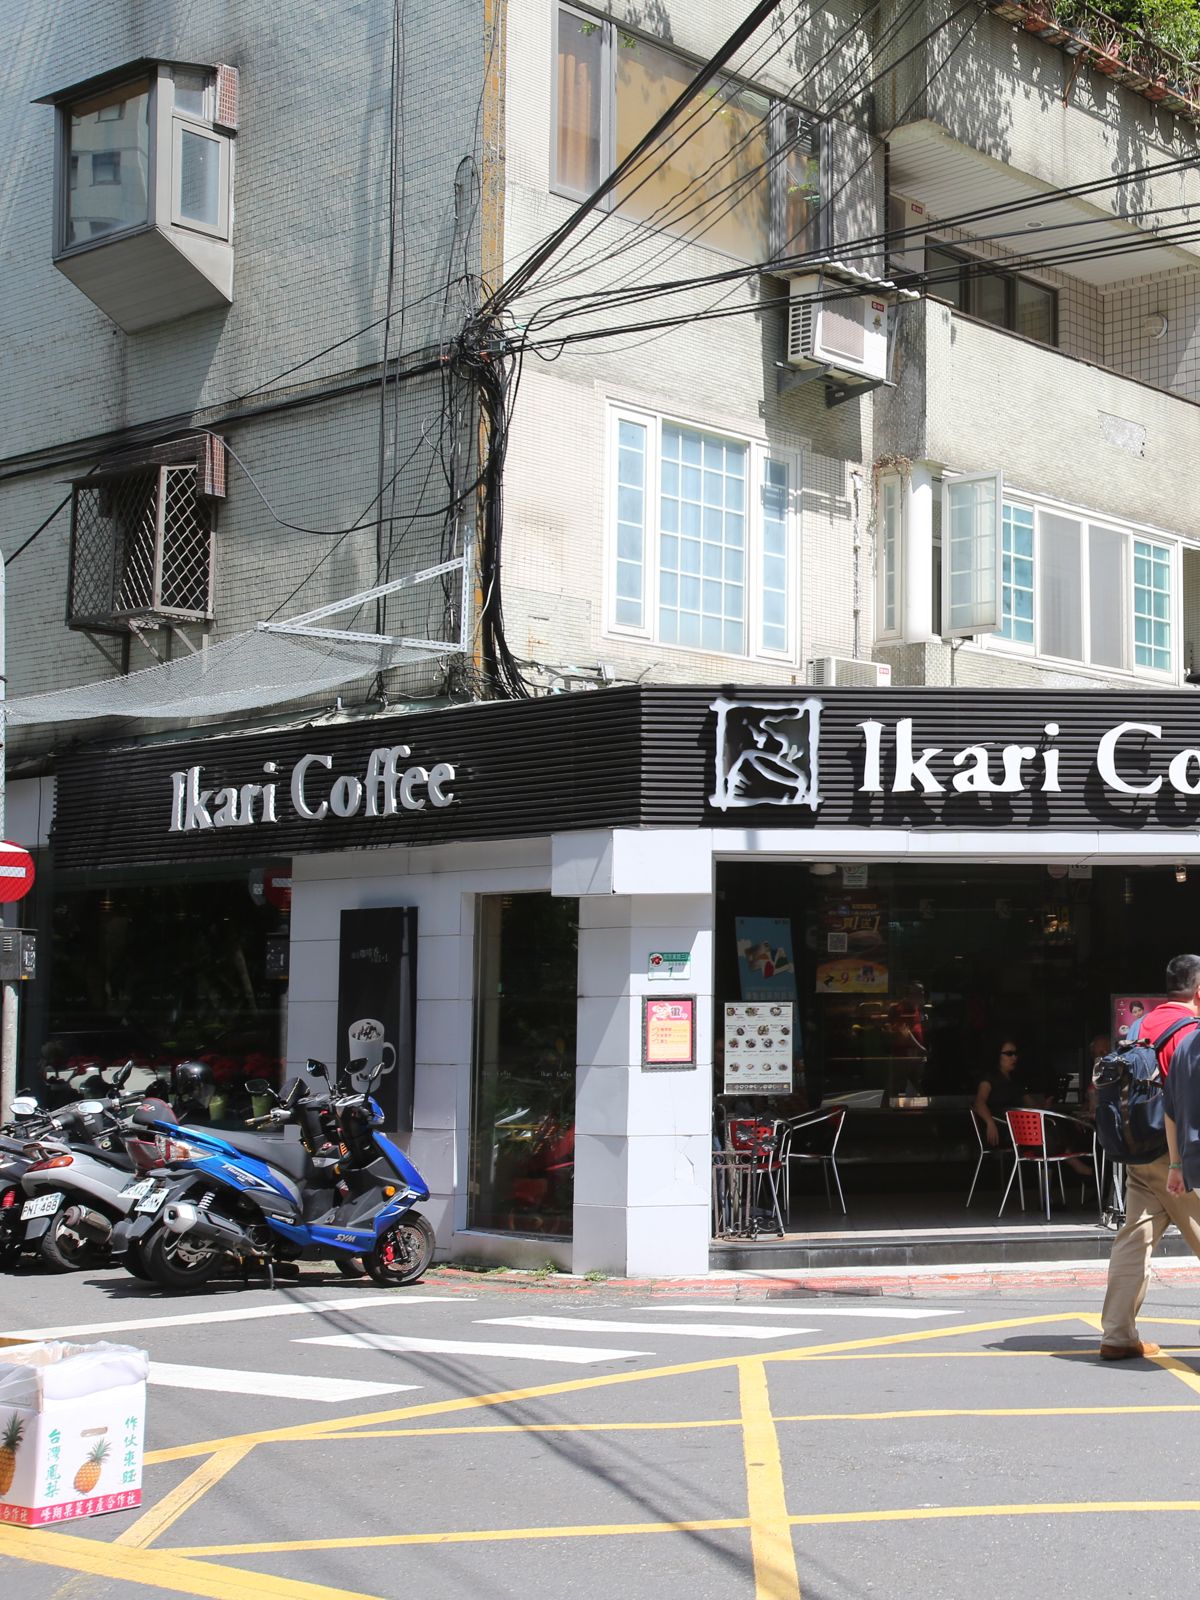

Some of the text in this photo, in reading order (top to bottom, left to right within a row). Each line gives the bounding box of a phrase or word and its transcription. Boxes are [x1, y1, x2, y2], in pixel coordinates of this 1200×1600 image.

[168, 745, 455, 831] Ikari Coffee
[857, 718, 1061, 793] Ikari
[334, 1233, 356, 1243] SYM
[44, 1428, 61, 1498] 台灣鳳梨
